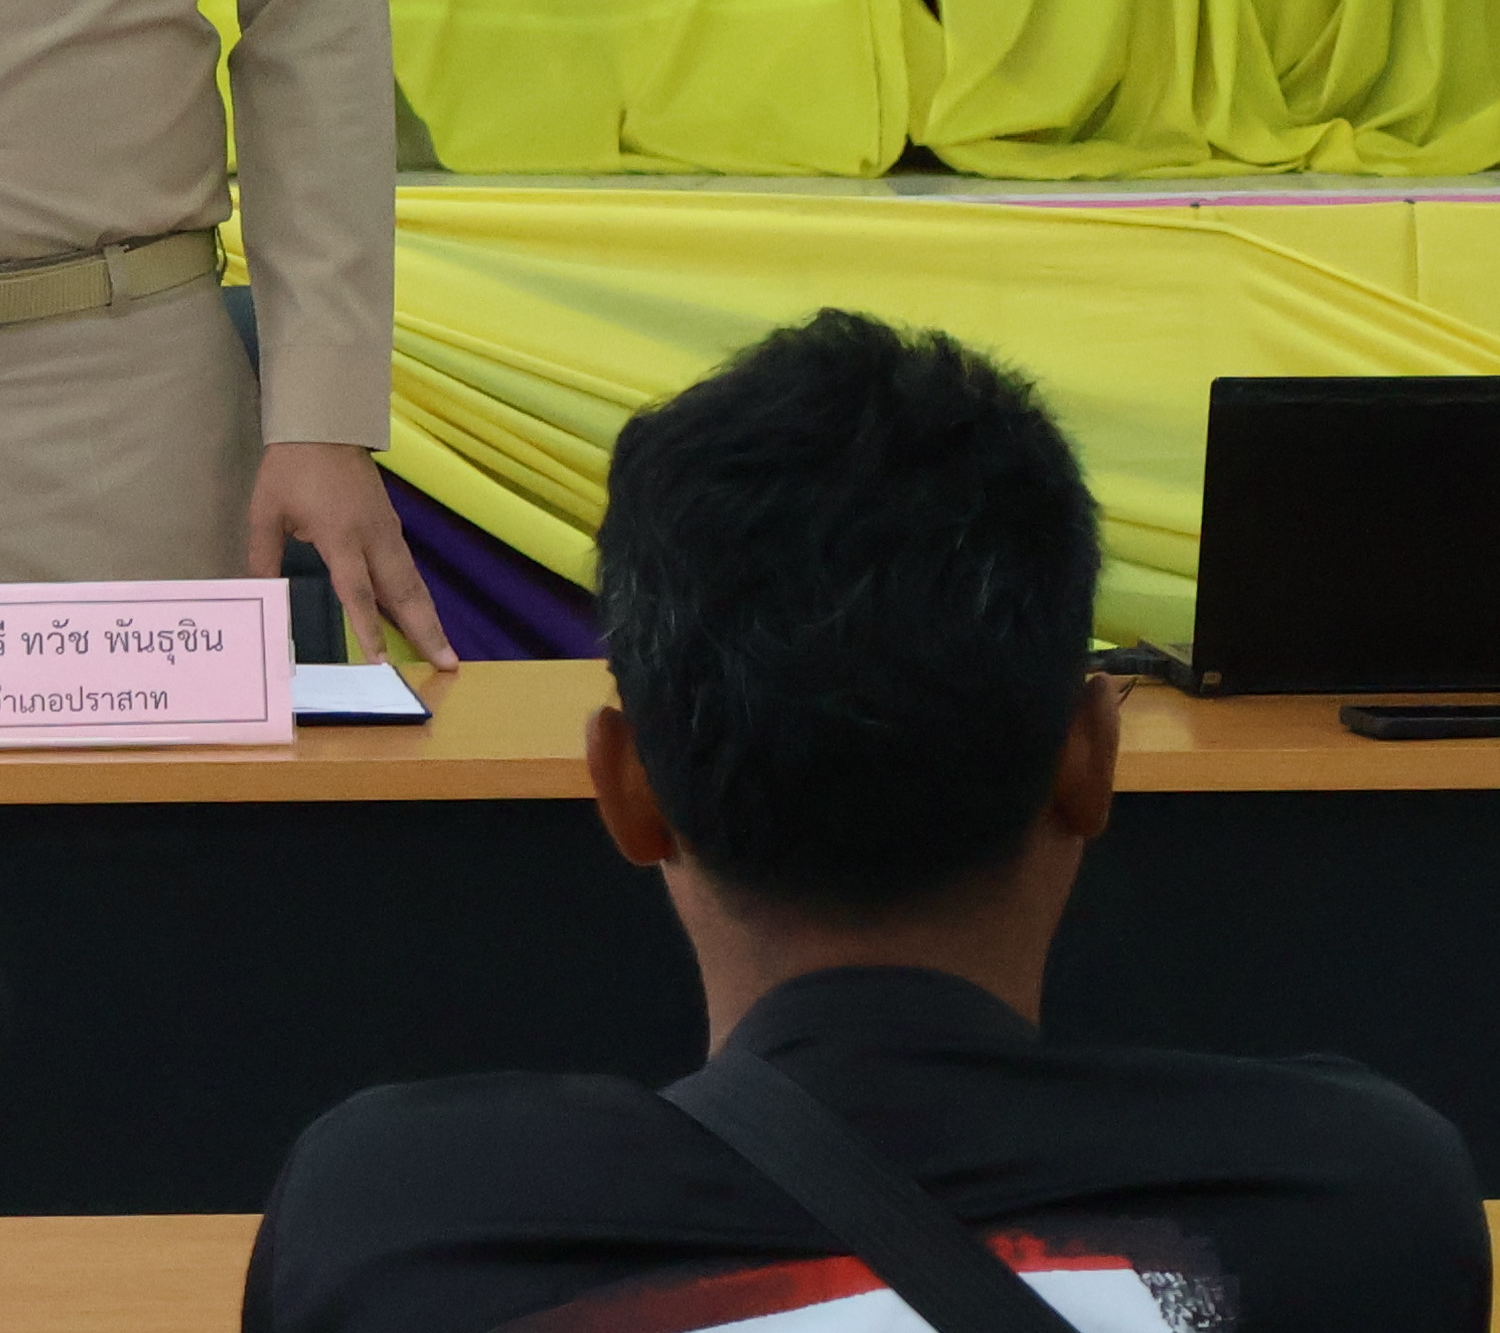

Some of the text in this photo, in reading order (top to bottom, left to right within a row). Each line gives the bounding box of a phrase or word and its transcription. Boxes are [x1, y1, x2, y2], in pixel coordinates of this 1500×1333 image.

[20, 618, 90, 656] ทวัช
[103, 617, 224, 666] พันธุชิน
